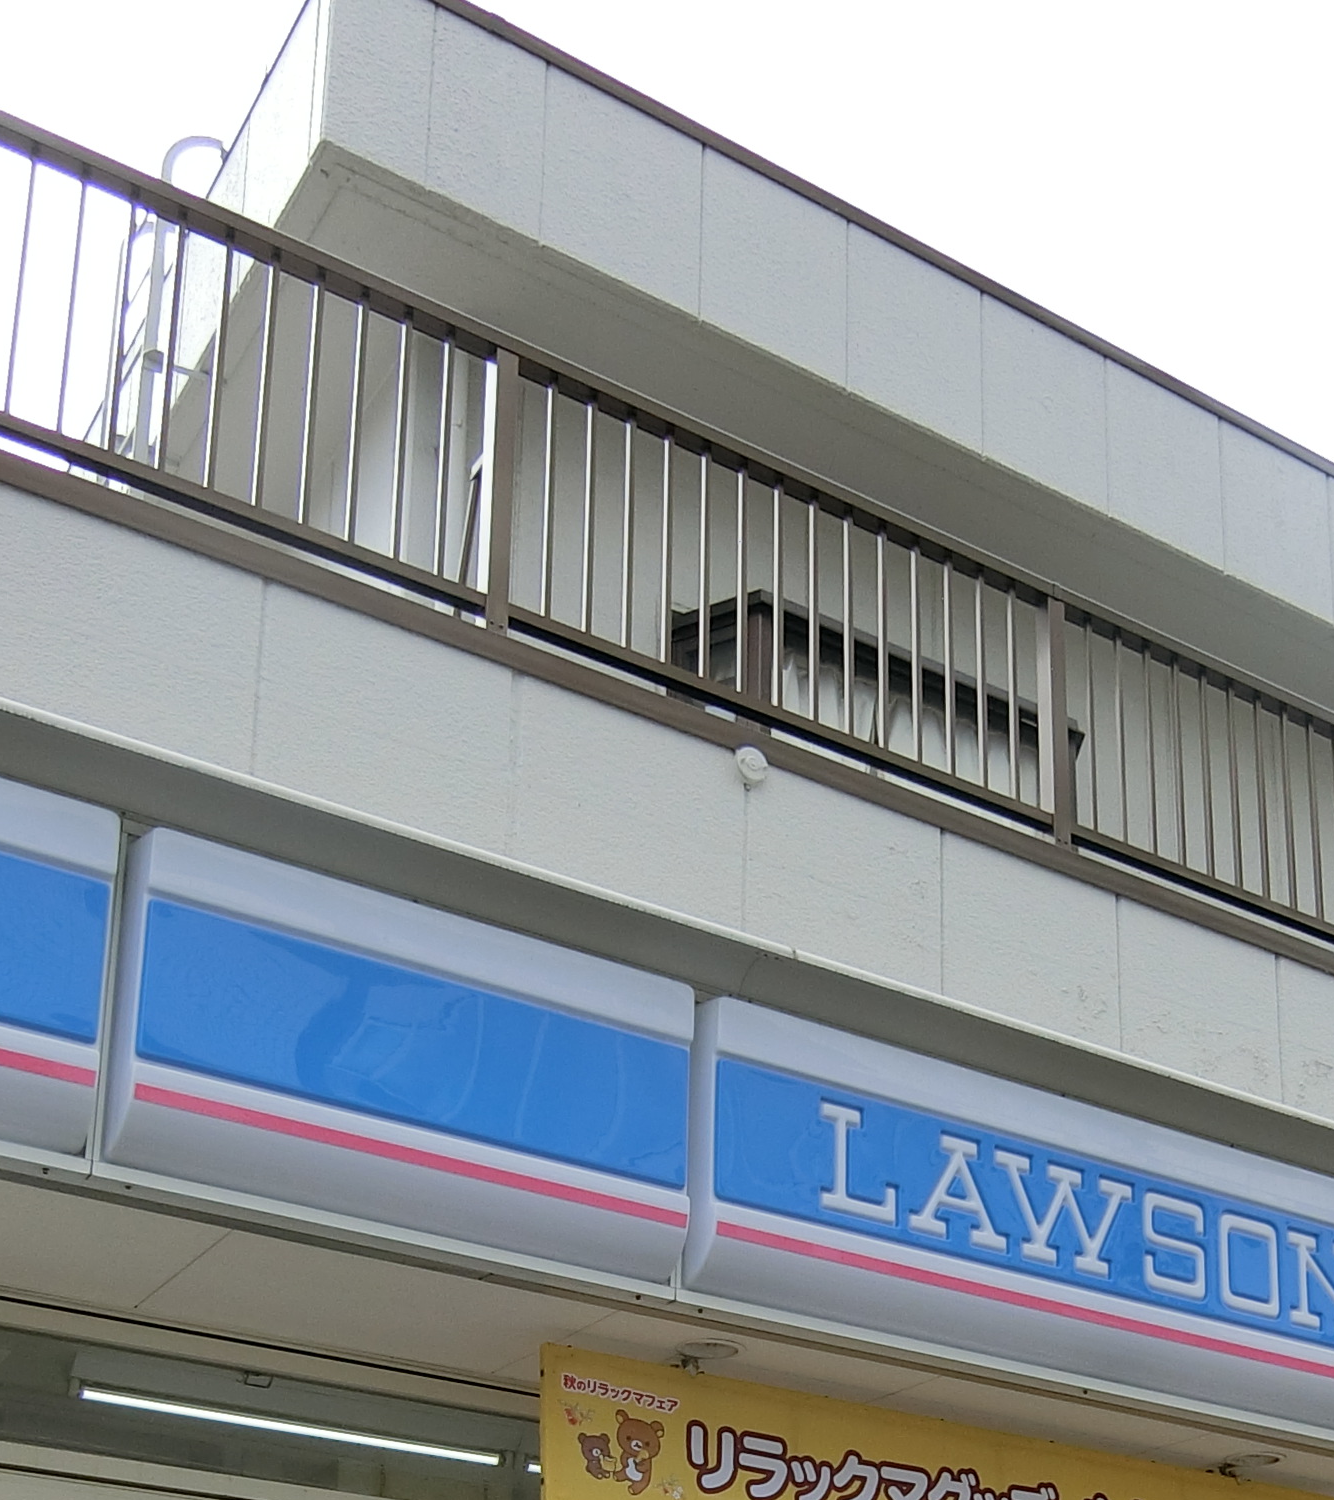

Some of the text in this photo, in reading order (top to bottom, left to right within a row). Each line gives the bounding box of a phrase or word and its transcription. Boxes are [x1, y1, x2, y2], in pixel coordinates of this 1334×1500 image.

[561, 1373, 680, 1412] 秋のリラックマフェア
